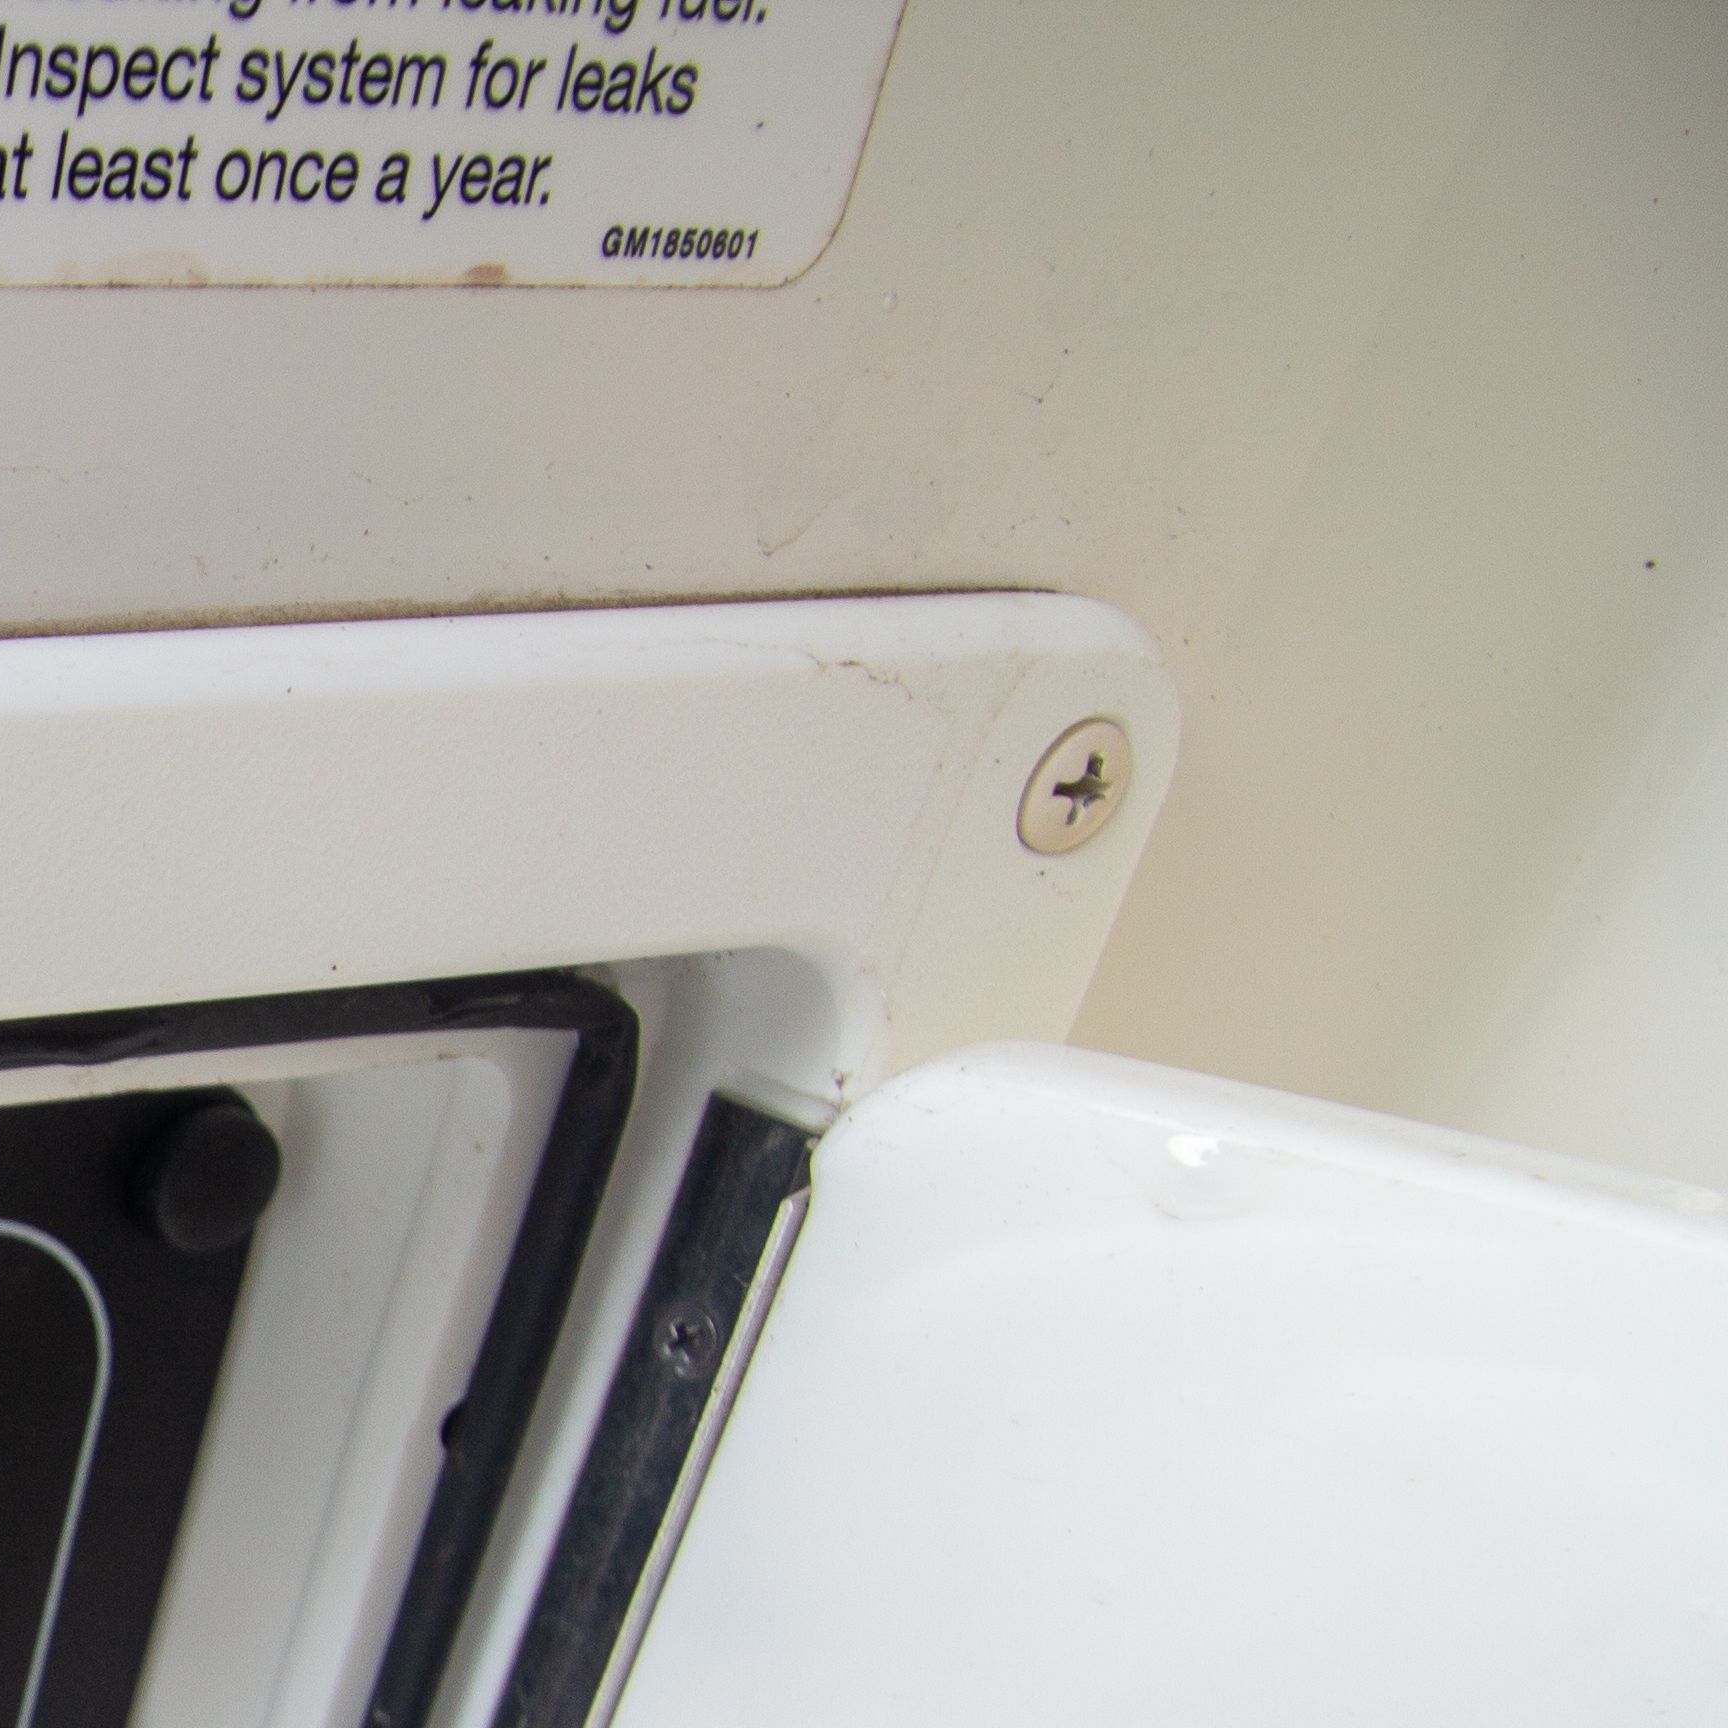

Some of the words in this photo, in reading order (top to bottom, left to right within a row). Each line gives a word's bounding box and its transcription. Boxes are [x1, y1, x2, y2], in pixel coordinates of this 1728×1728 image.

[235, 39, 447, 123] system
[464, 39, 547, 111] for
[556, 43, 698, 117] leaks
[51, 130, 199, 203] least
[214, 149, 360, 204] once
[374, 152, 411, 205] a
[421, 153, 553, 222] year.
[600, 224, 759, 261] GM1850601
